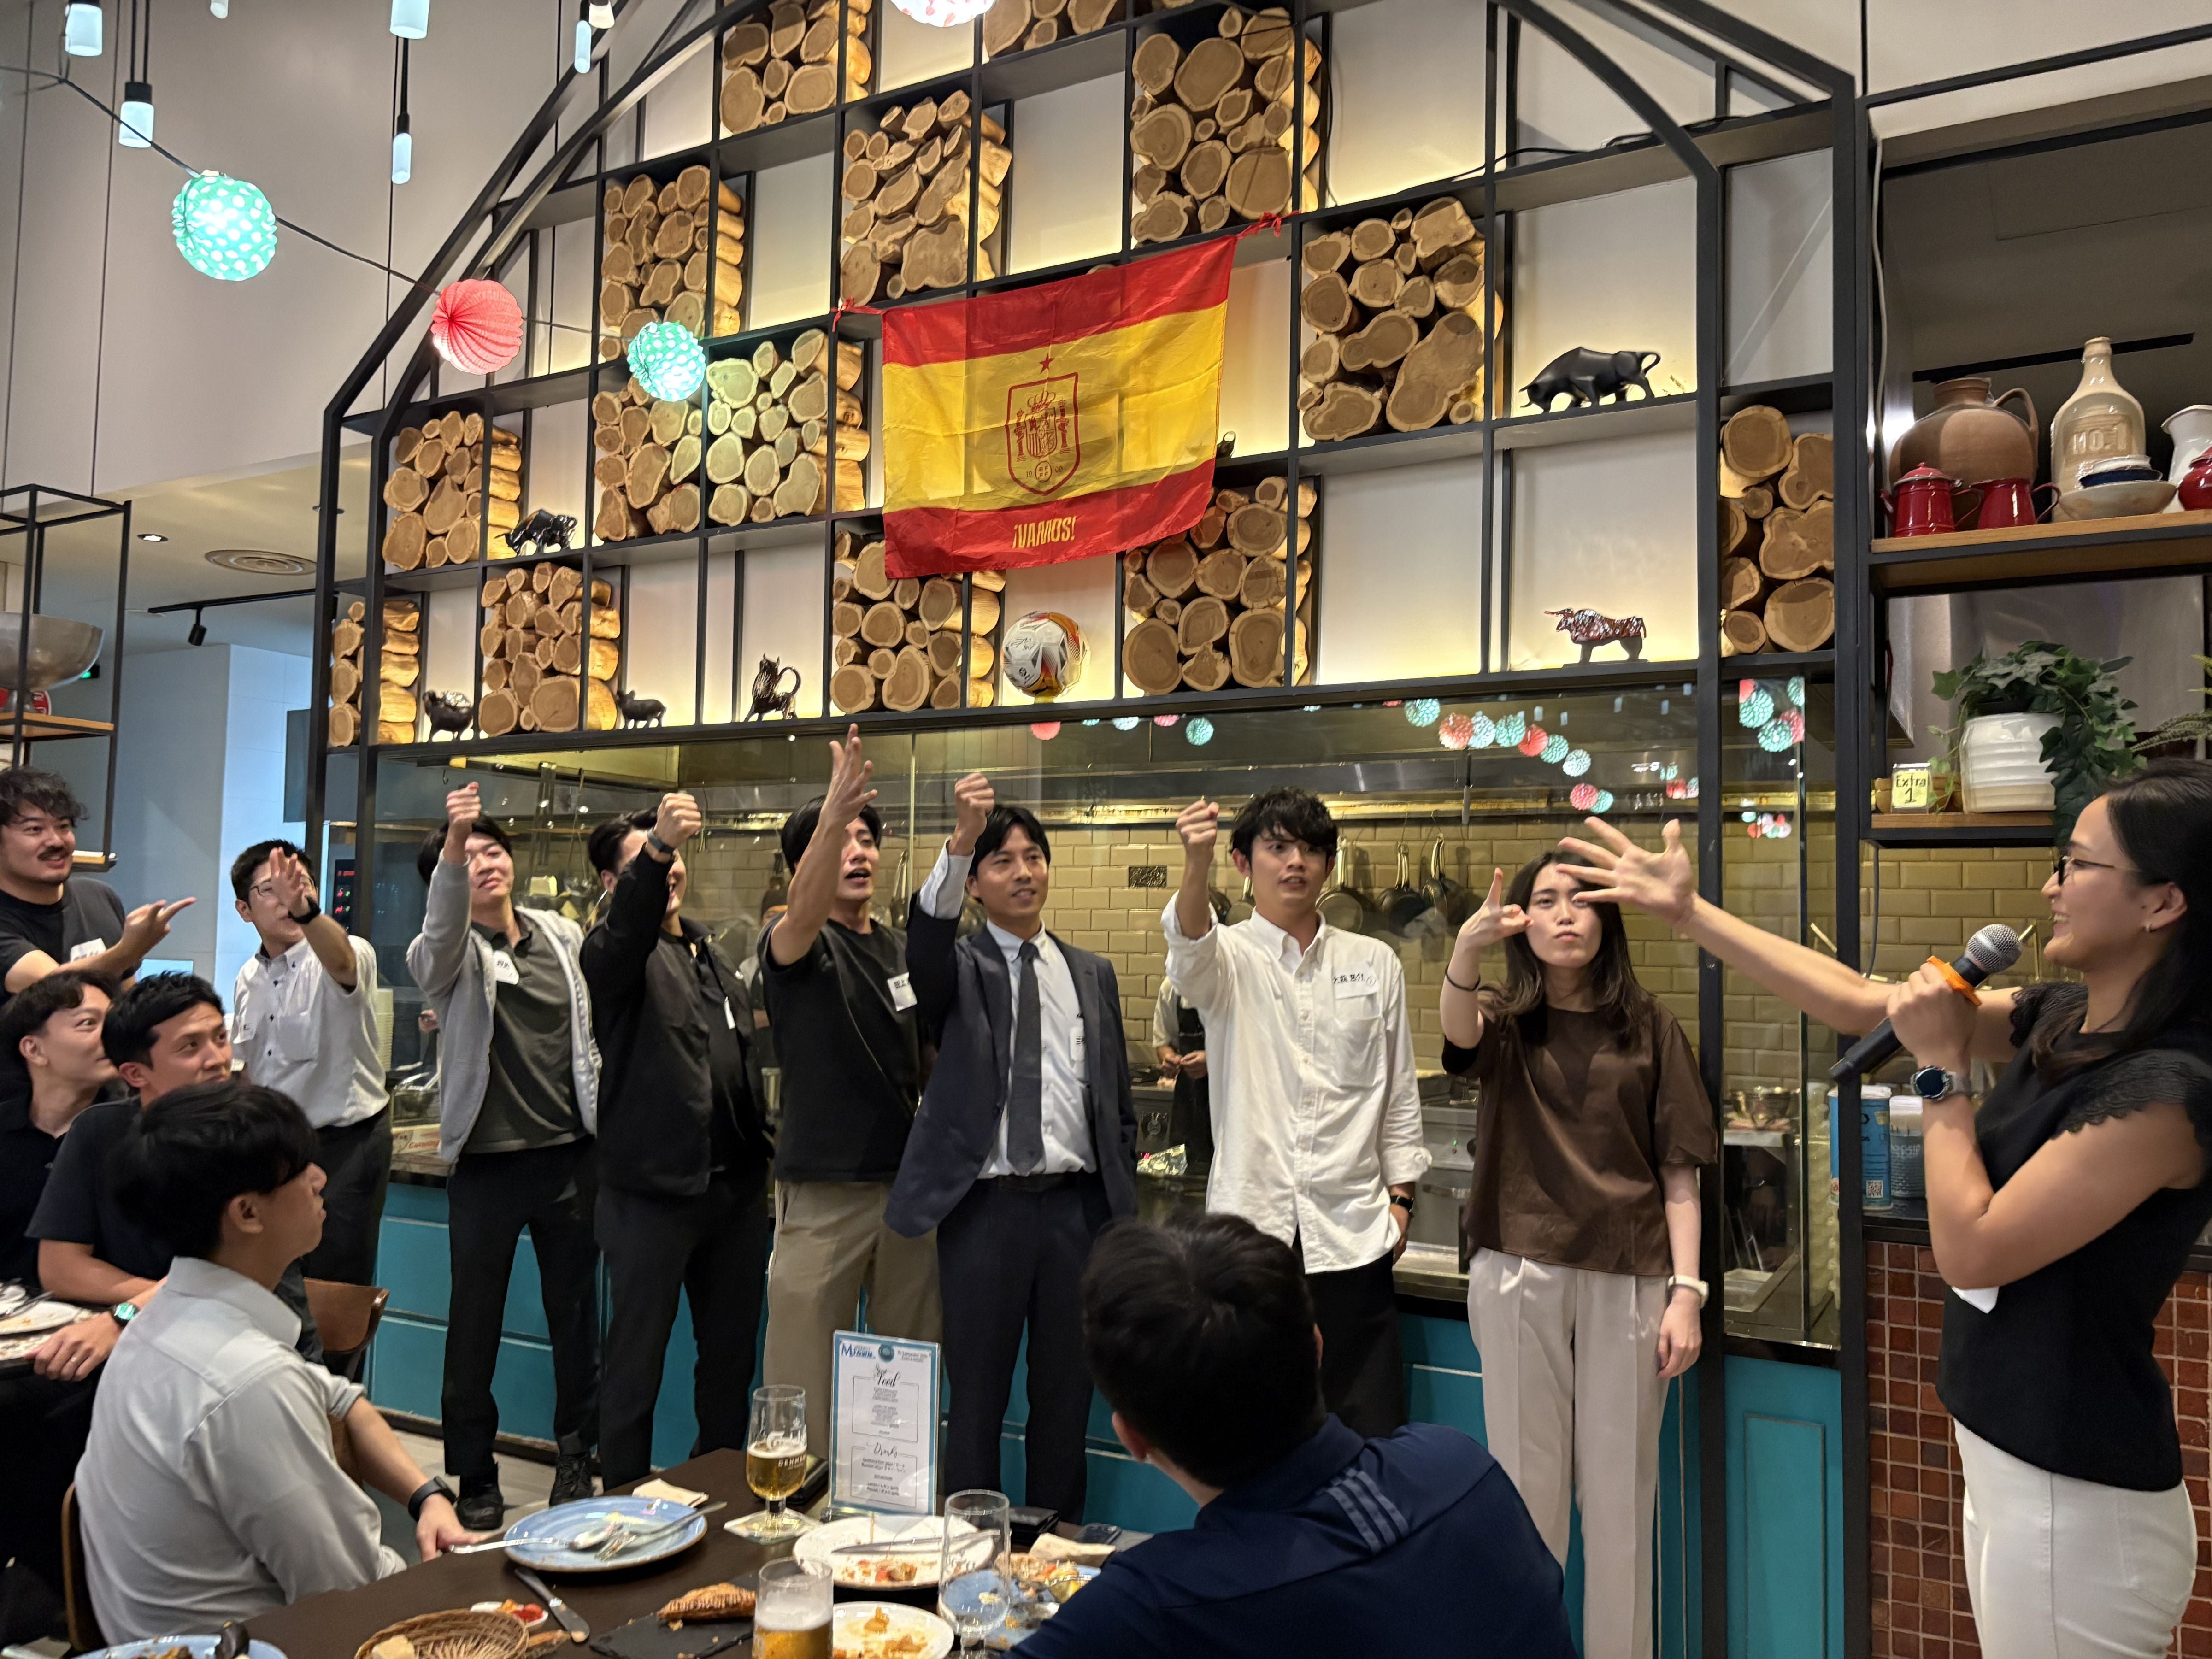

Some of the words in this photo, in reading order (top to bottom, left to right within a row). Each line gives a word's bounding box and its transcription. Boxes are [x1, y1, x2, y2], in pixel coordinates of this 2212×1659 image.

[2073, 421, 2127, 454] NO.1
[1012, 516, 1077, 548] ¡VAMOS!
[1896, 774, 1926, 787] Extra
[1905, 788, 1917, 804] 1
